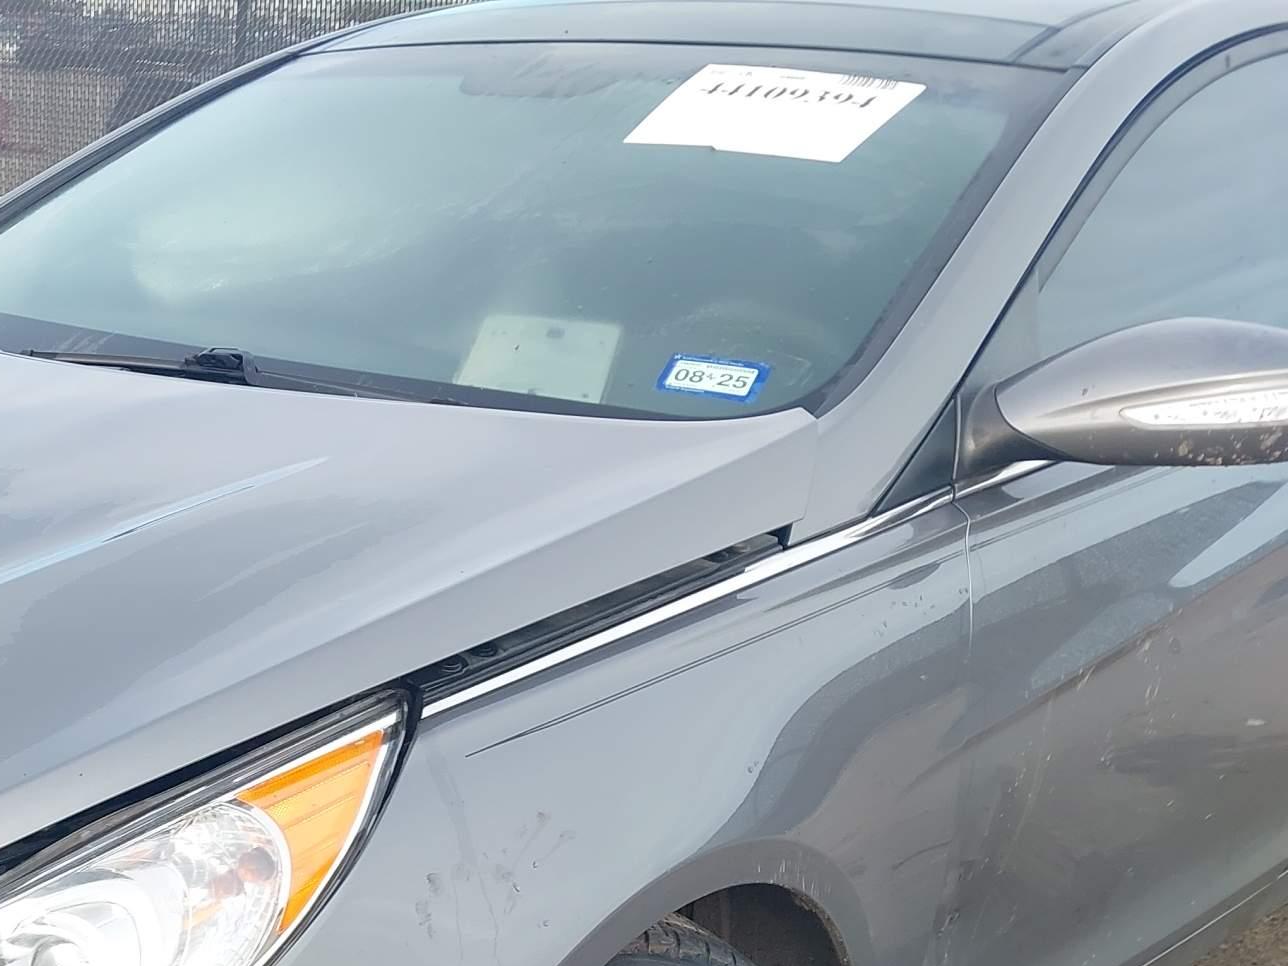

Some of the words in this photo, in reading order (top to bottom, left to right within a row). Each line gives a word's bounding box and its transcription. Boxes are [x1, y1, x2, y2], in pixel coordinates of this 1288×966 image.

[700, 81, 878, 108] 44109394
[674, 368, 706, 383] 08
[716, 373, 751, 389] 25
